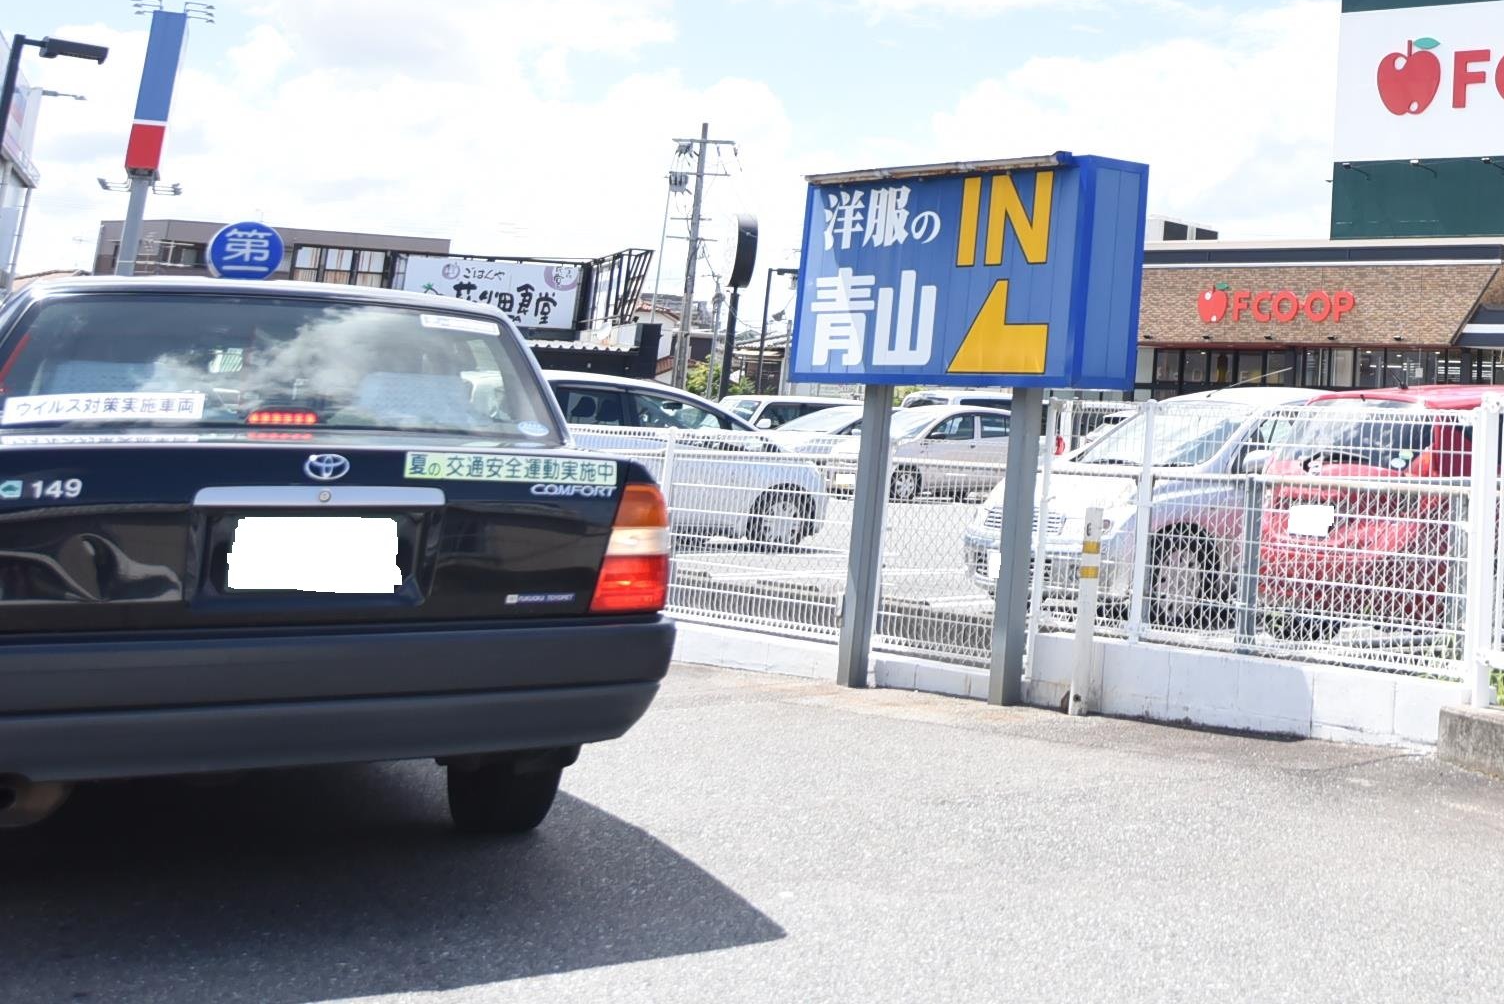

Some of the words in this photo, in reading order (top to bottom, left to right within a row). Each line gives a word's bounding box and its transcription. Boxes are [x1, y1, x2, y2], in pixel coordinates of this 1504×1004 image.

[822, 184, 941, 252] 洋服の
[956, 170, 1055, 267] IN
[222, 228, 272, 272] 第一
[810, 267, 937, 367] 青山
[16, 397, 195, 417] ウイルス対策実施車両
[31, 478, 83, 499] 149
[529, 483, 617, 497] COMFORT
